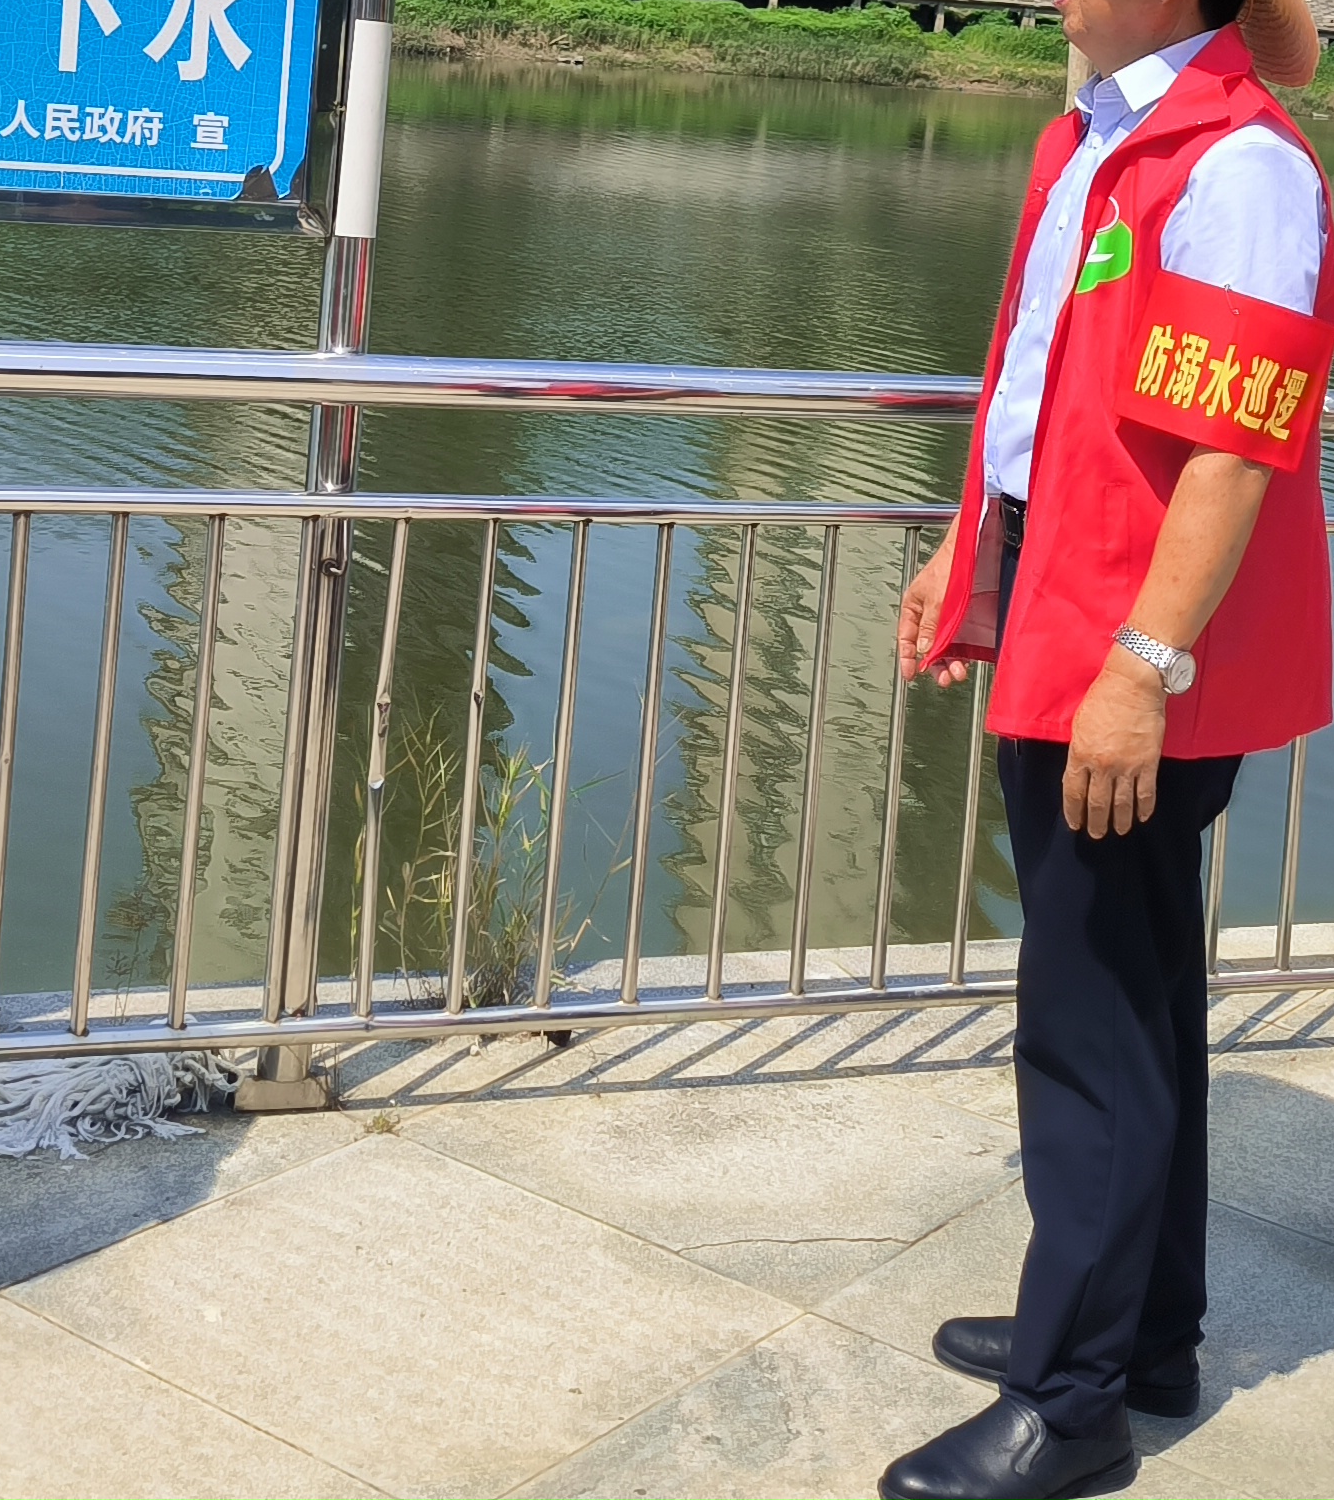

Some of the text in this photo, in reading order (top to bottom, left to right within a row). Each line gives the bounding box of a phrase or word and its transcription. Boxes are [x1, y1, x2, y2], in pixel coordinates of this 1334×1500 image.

[190, 112, 230, 151] 宣
[1134, 324, 1310, 442] 防溺水巡逻
